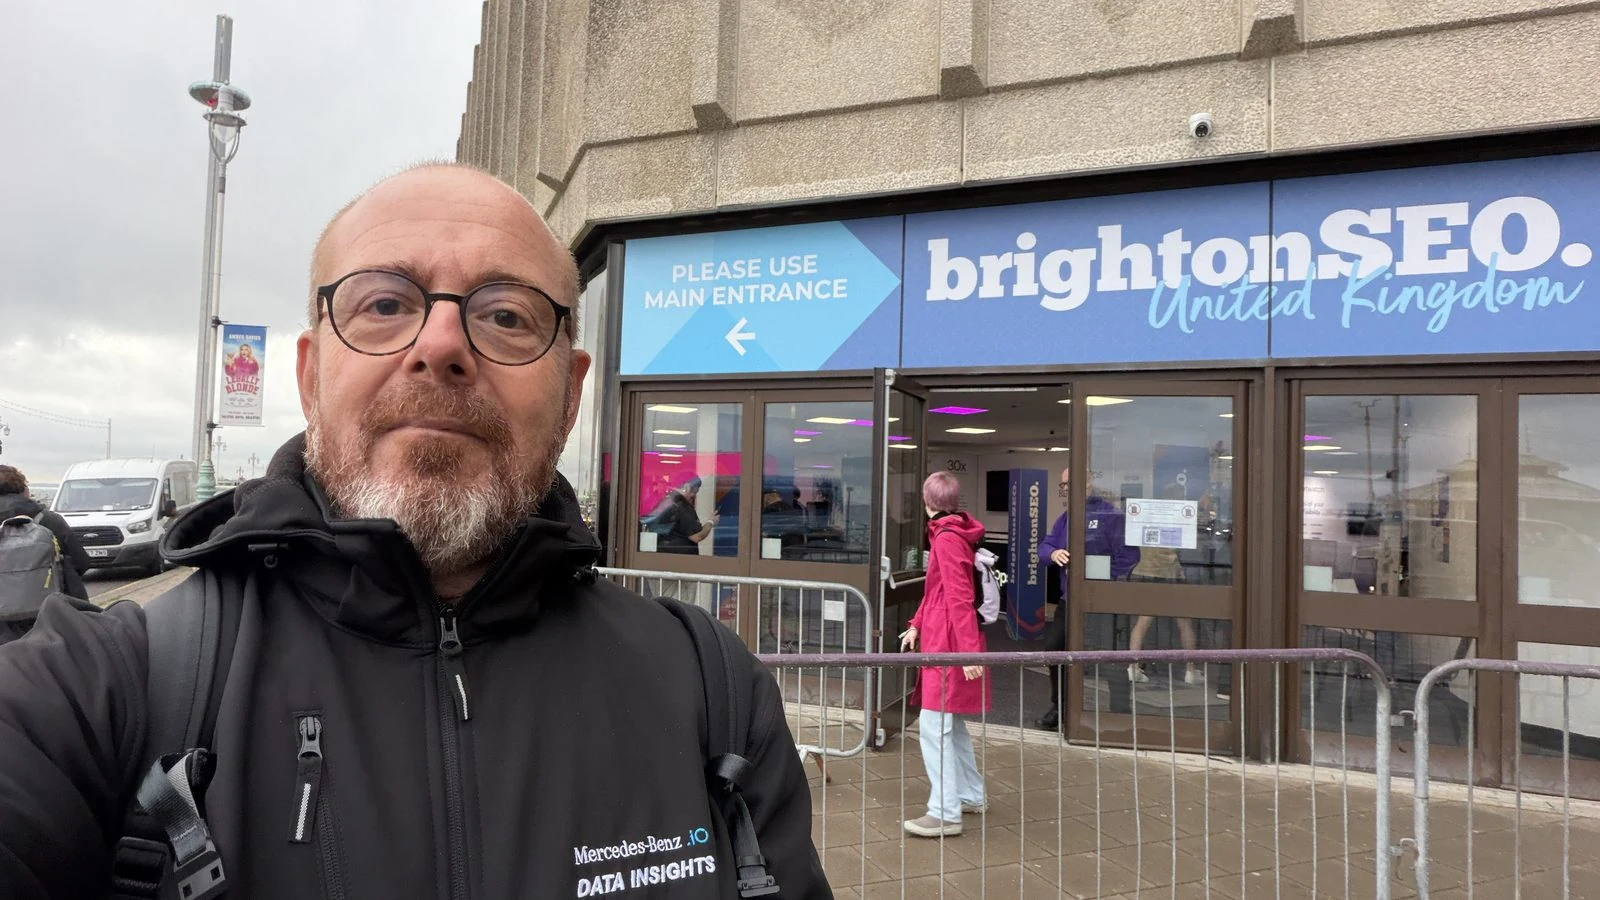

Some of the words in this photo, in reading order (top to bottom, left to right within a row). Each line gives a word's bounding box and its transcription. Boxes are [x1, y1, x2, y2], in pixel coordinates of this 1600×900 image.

[672, 258, 761, 284] PLEASE
[769, 254, 818, 278] USE
[926, 196, 1593, 311] brightonSEO.
[644, 287, 705, 309] MAIN
[712, 278, 848, 306] ENTRANCE
[1147, 261, 1316, 334] United
[1340, 251, 1585, 334] Kingdom
[225, 383, 260, 395] BLONDE
[947, 460, 967, 471] 30x
[1027, 481, 1040, 585] brightonSEO.
[573, 834, 682, 865] Mercedes-Benz
[577, 870, 625, 898] DATA
[630, 855, 715, 889] INSIGHTS
